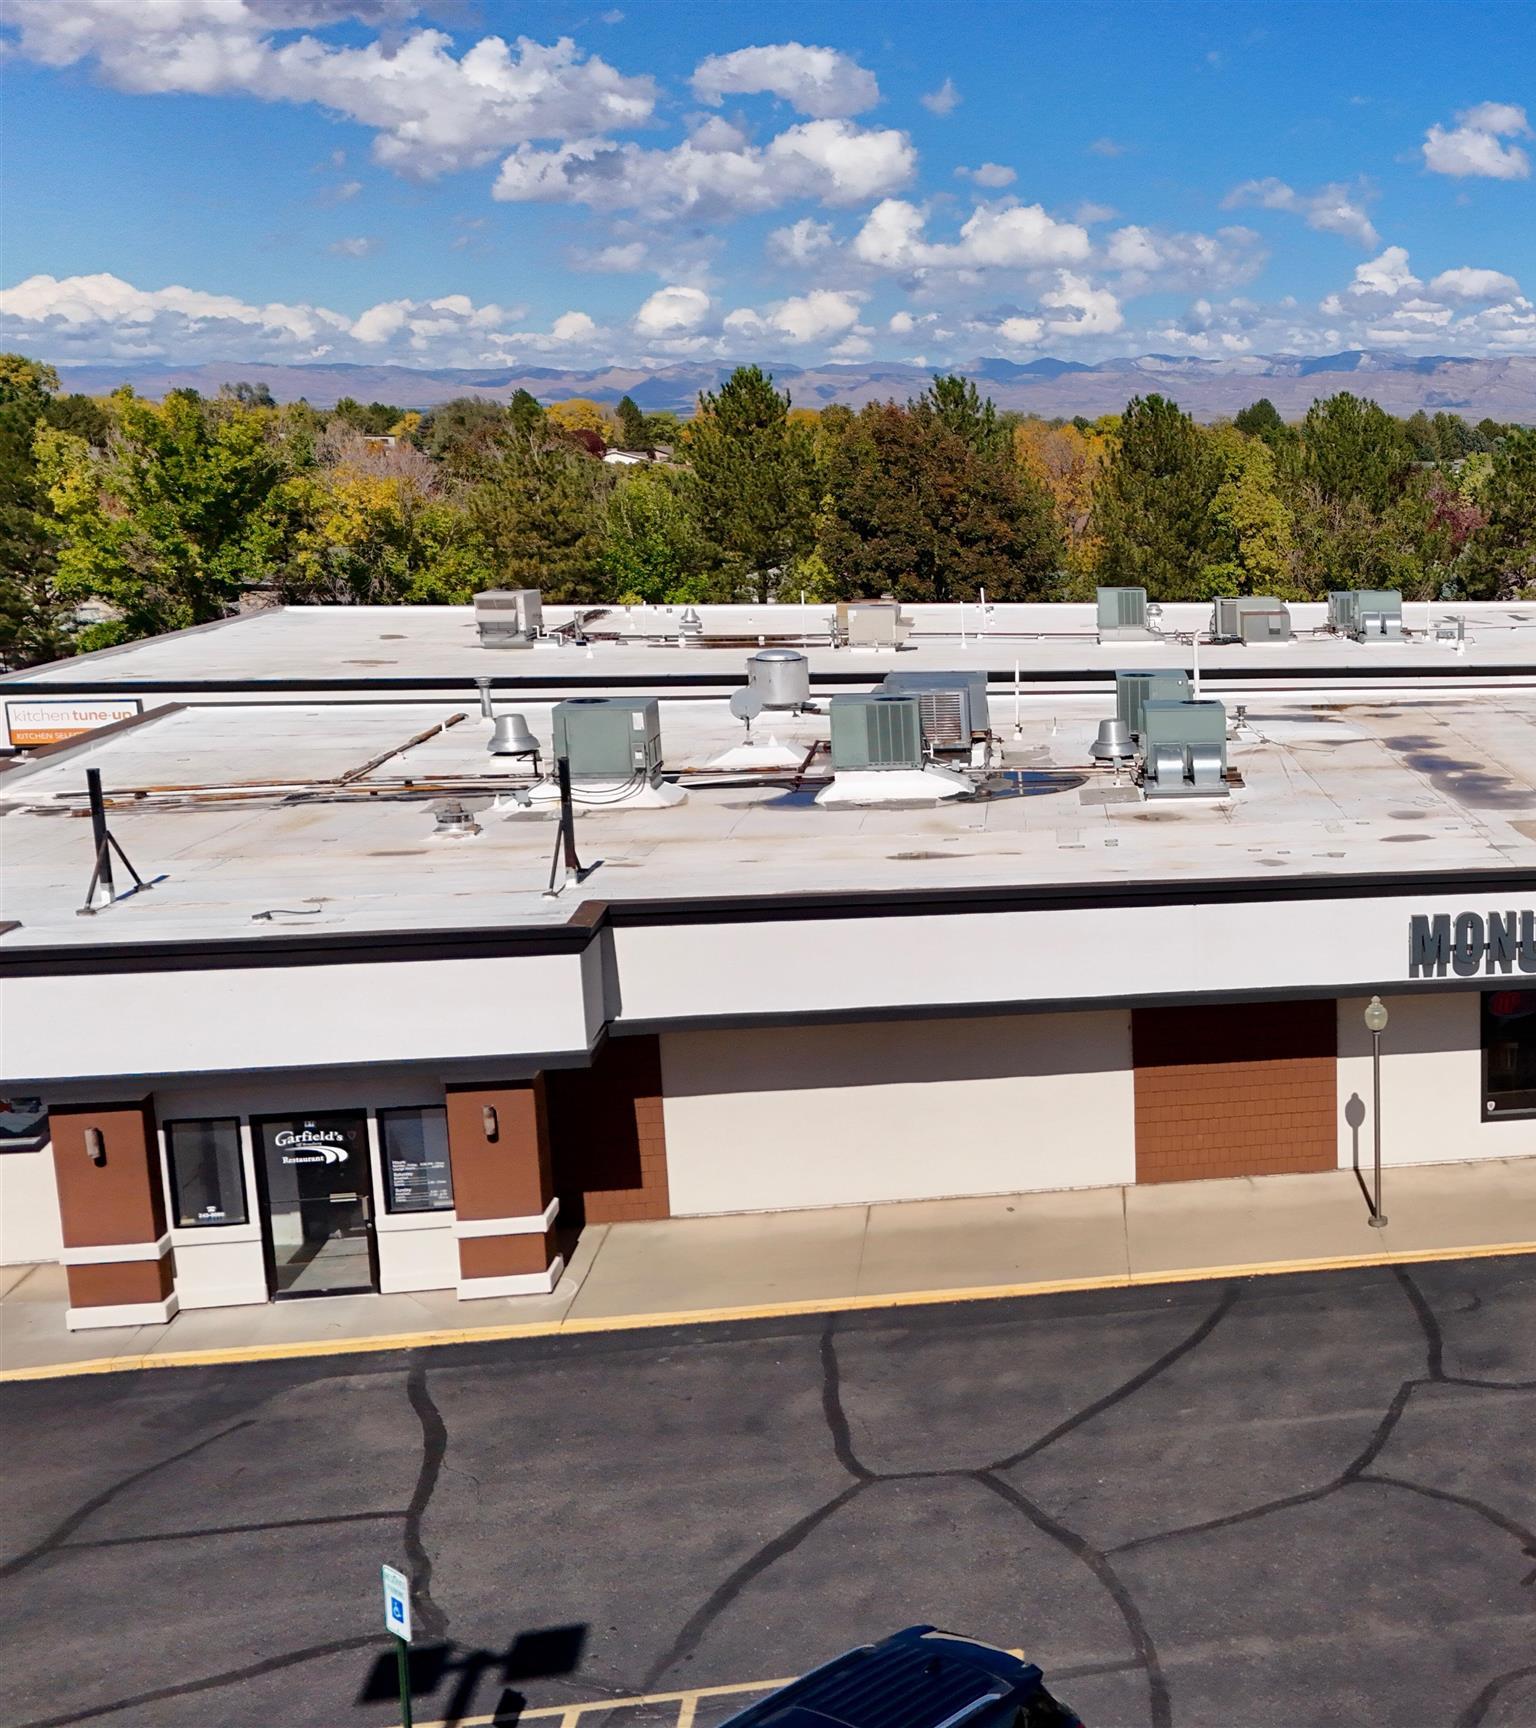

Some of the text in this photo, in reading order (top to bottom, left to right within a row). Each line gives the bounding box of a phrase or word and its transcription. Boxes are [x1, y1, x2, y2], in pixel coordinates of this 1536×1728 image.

[14, 706, 69, 721] kitchen
[16, 732, 54, 740] KITCHEN
[275, 1130, 344, 1147] Garfield's
[282, 1155, 325, 1164] Restaurant
